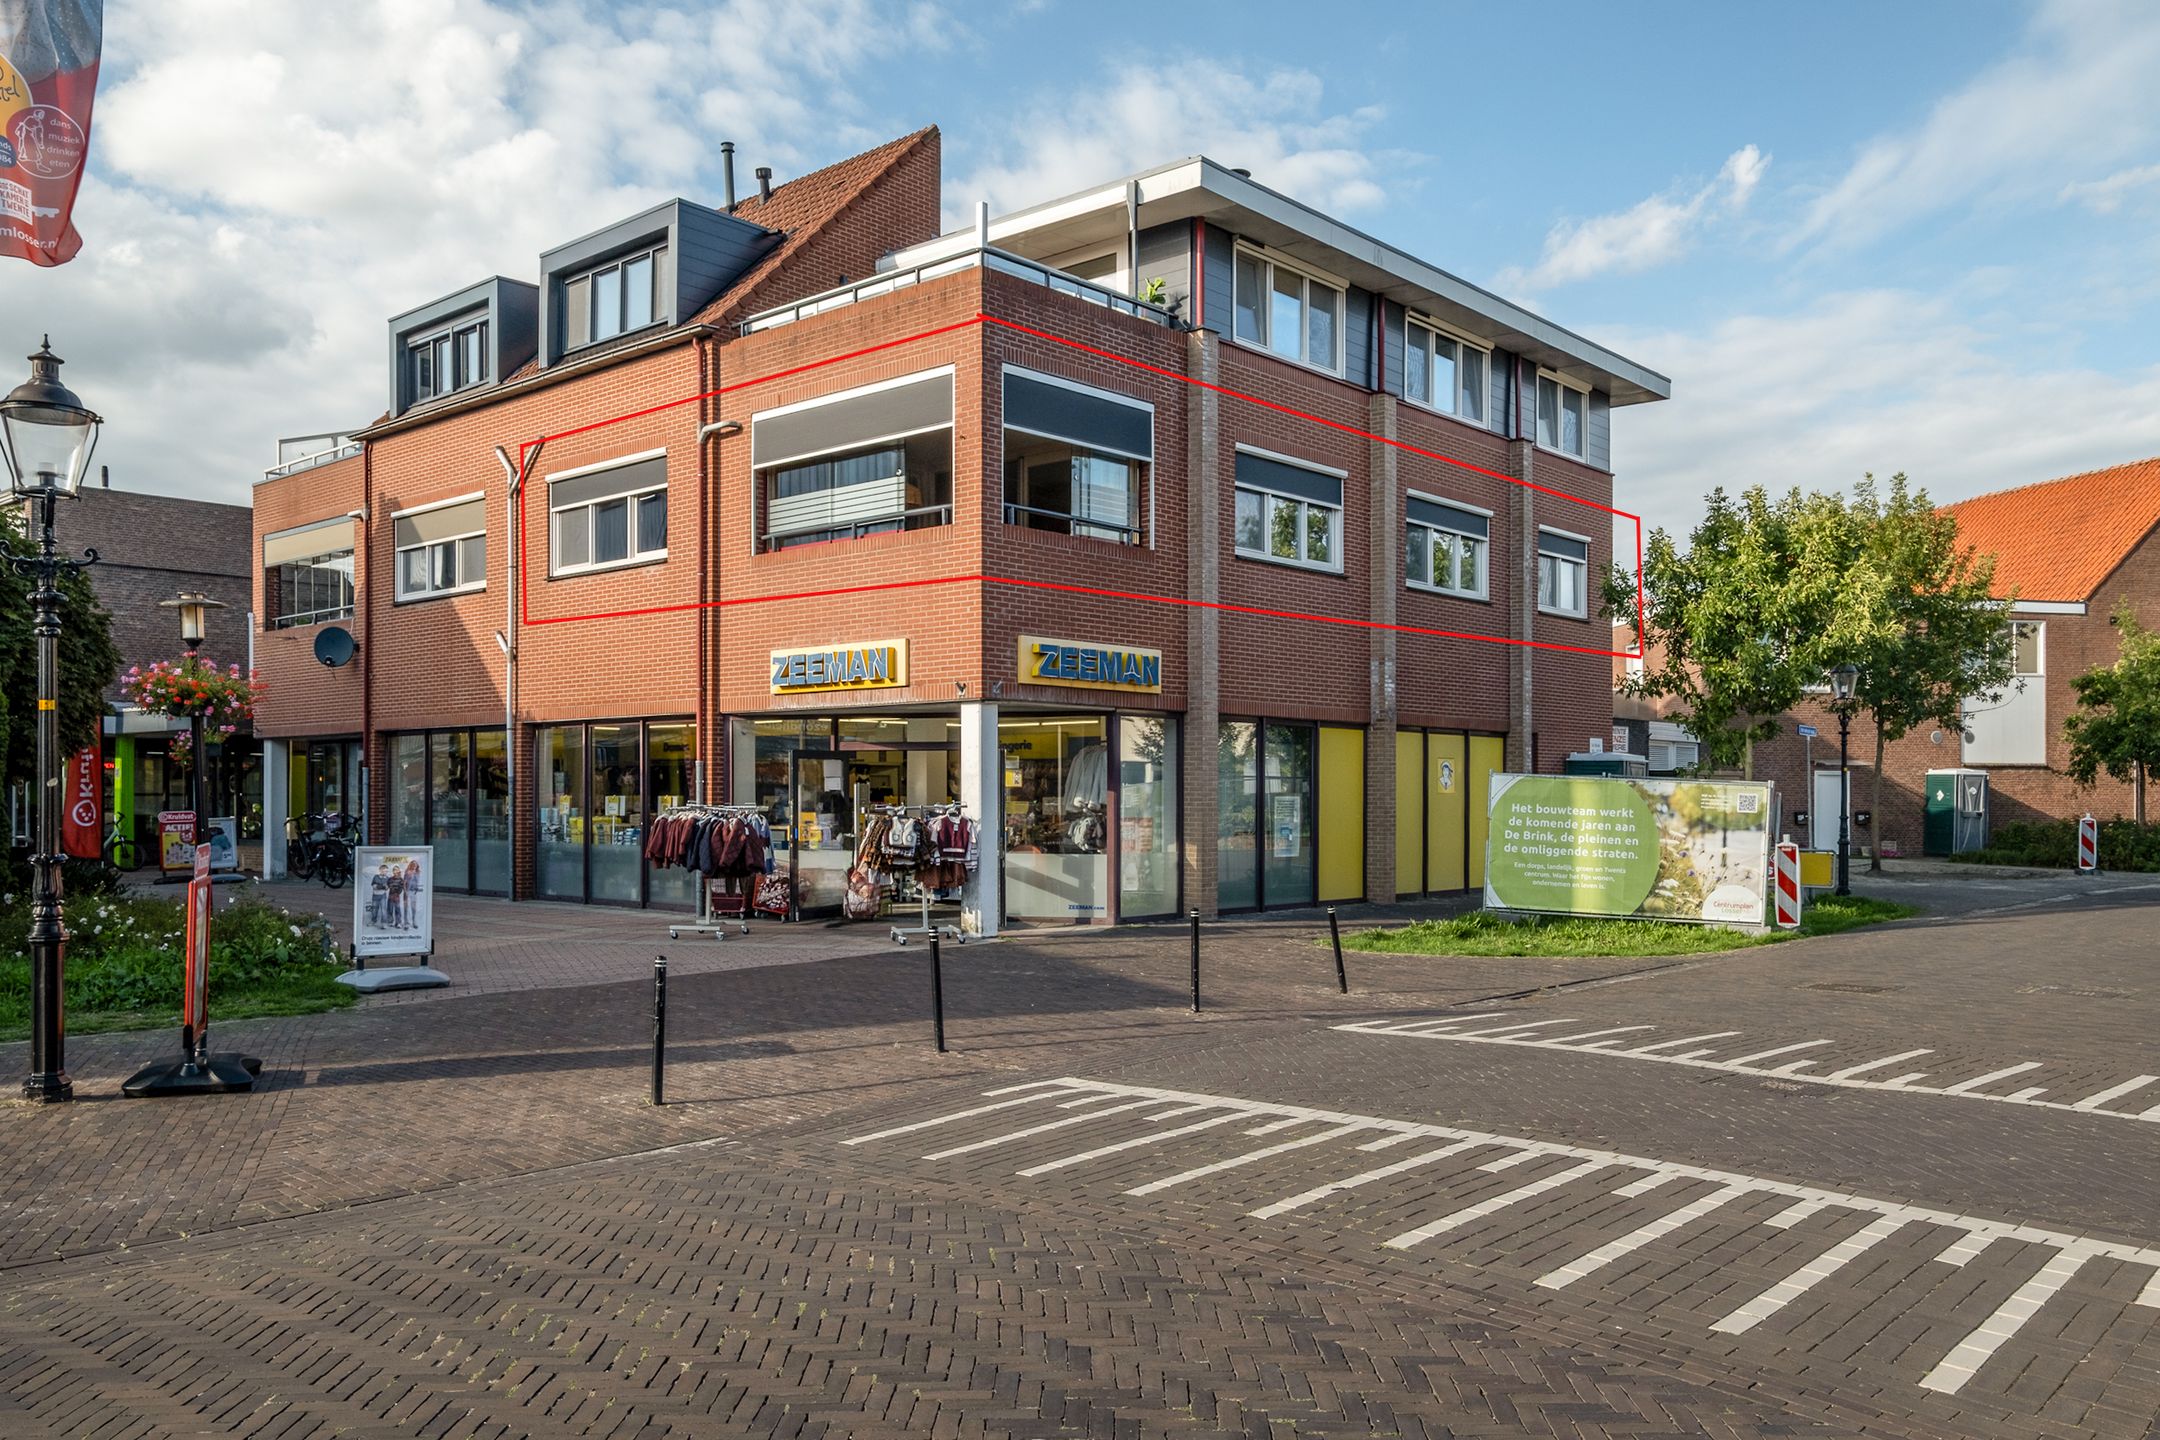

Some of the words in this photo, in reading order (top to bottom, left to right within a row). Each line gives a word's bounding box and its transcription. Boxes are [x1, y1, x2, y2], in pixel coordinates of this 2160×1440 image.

[50, 118, 71, 129] dans
[48, 133, 80, 144] muziek
[47, 146, 80, 157] drinken
[49, 160, 70, 168] eten
[2, 199, 30, 217] TWENTE
[772, 647, 889, 686] ZEEMAN
[1035, 643, 1160, 686] ZEEMAN
[1512, 803, 1533, 813] Het
[1536, 804, 1596, 816] bouwteam
[1600, 808, 1634, 818] werkt
[1508, 816, 1522, 826] de
[1526, 817, 1578, 829] komende
[1581, 820, 1611, 831] jaren
[1615, 823, 1636, 832] aan
[1504, 830, 1520, 839] De
[1523, 831, 1557, 843] Brink,
[1560, 832, 1575, 842] de
[1578, 834, 1621, 845] pleinen
[1625, 837, 1639, 846] en
[1504, 843, 1518, 853] de
[1521, 844, 1588, 857] omliggende
[1592, 849, 1638, 859] straten.
[1713, 901, 1754, 909] Centrumplan
